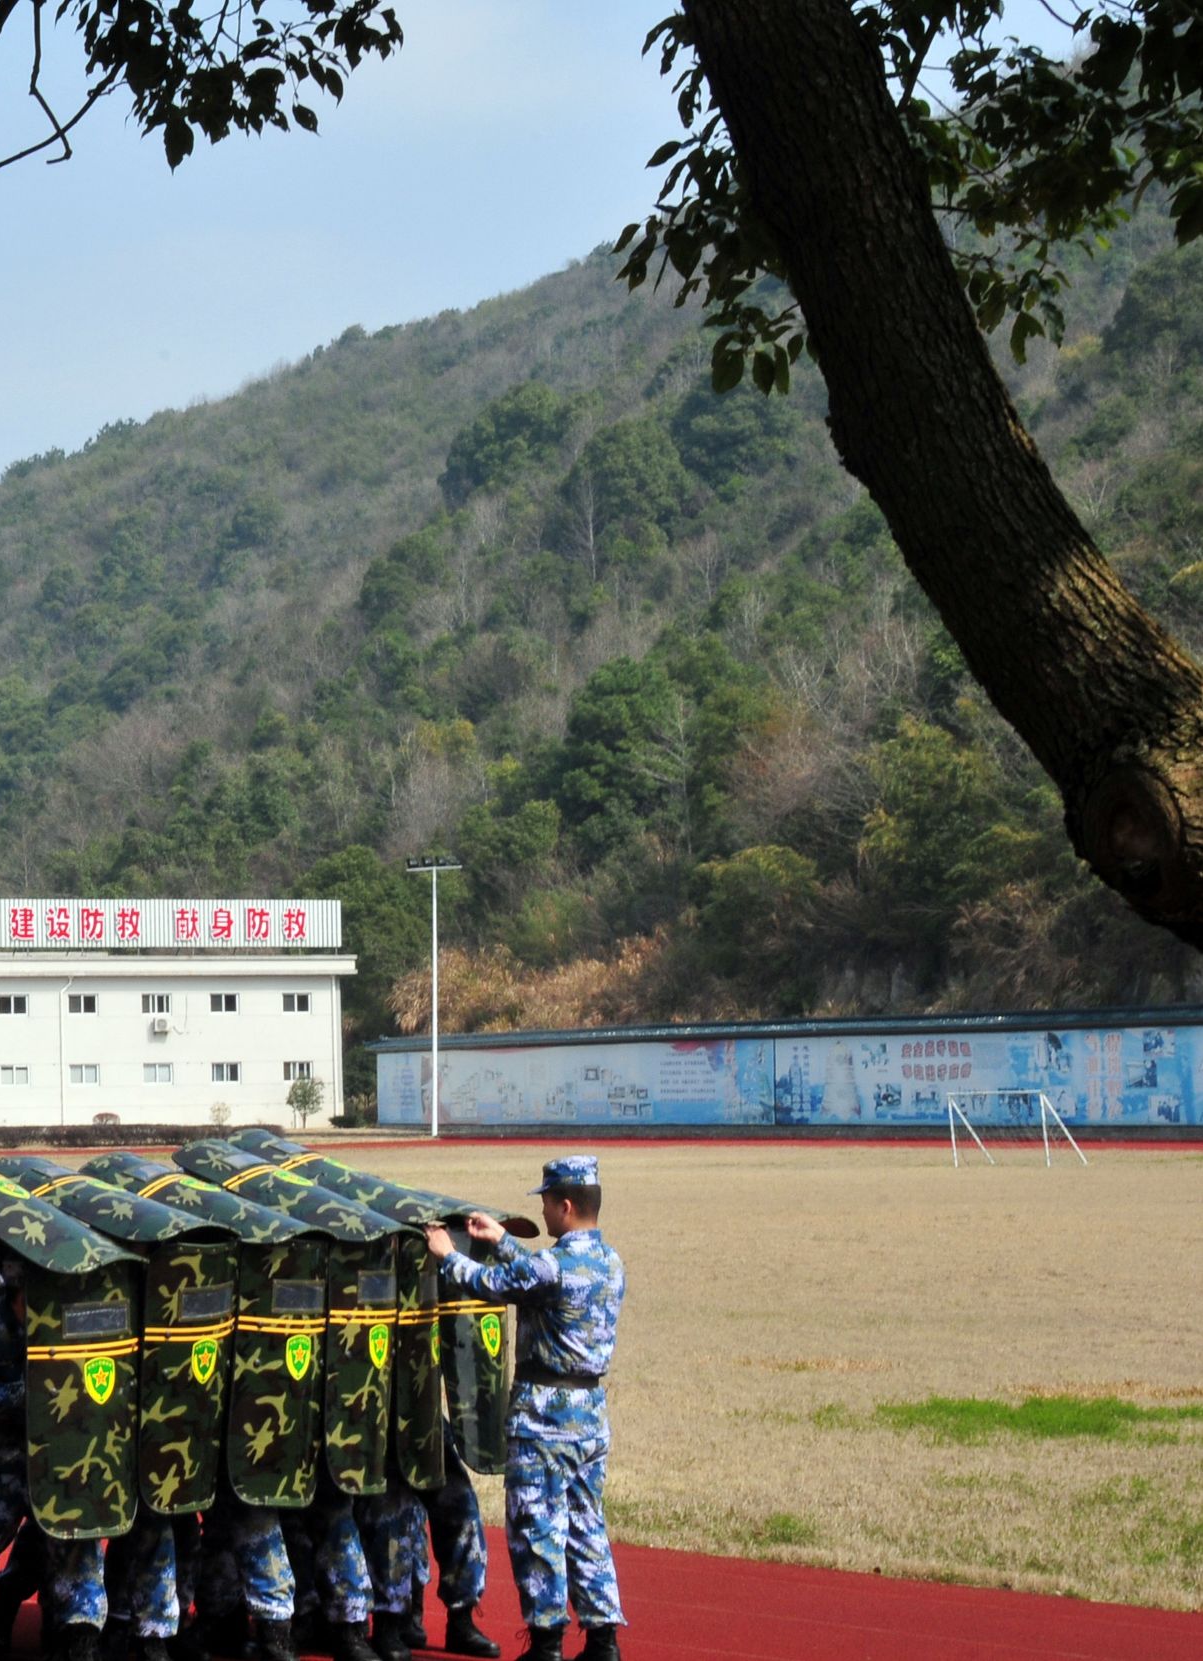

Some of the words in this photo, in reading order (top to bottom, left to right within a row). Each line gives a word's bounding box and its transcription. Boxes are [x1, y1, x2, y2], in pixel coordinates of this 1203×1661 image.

[9, 906, 142, 940] 建设防救
[175, 906, 308, 940] 献身防救
